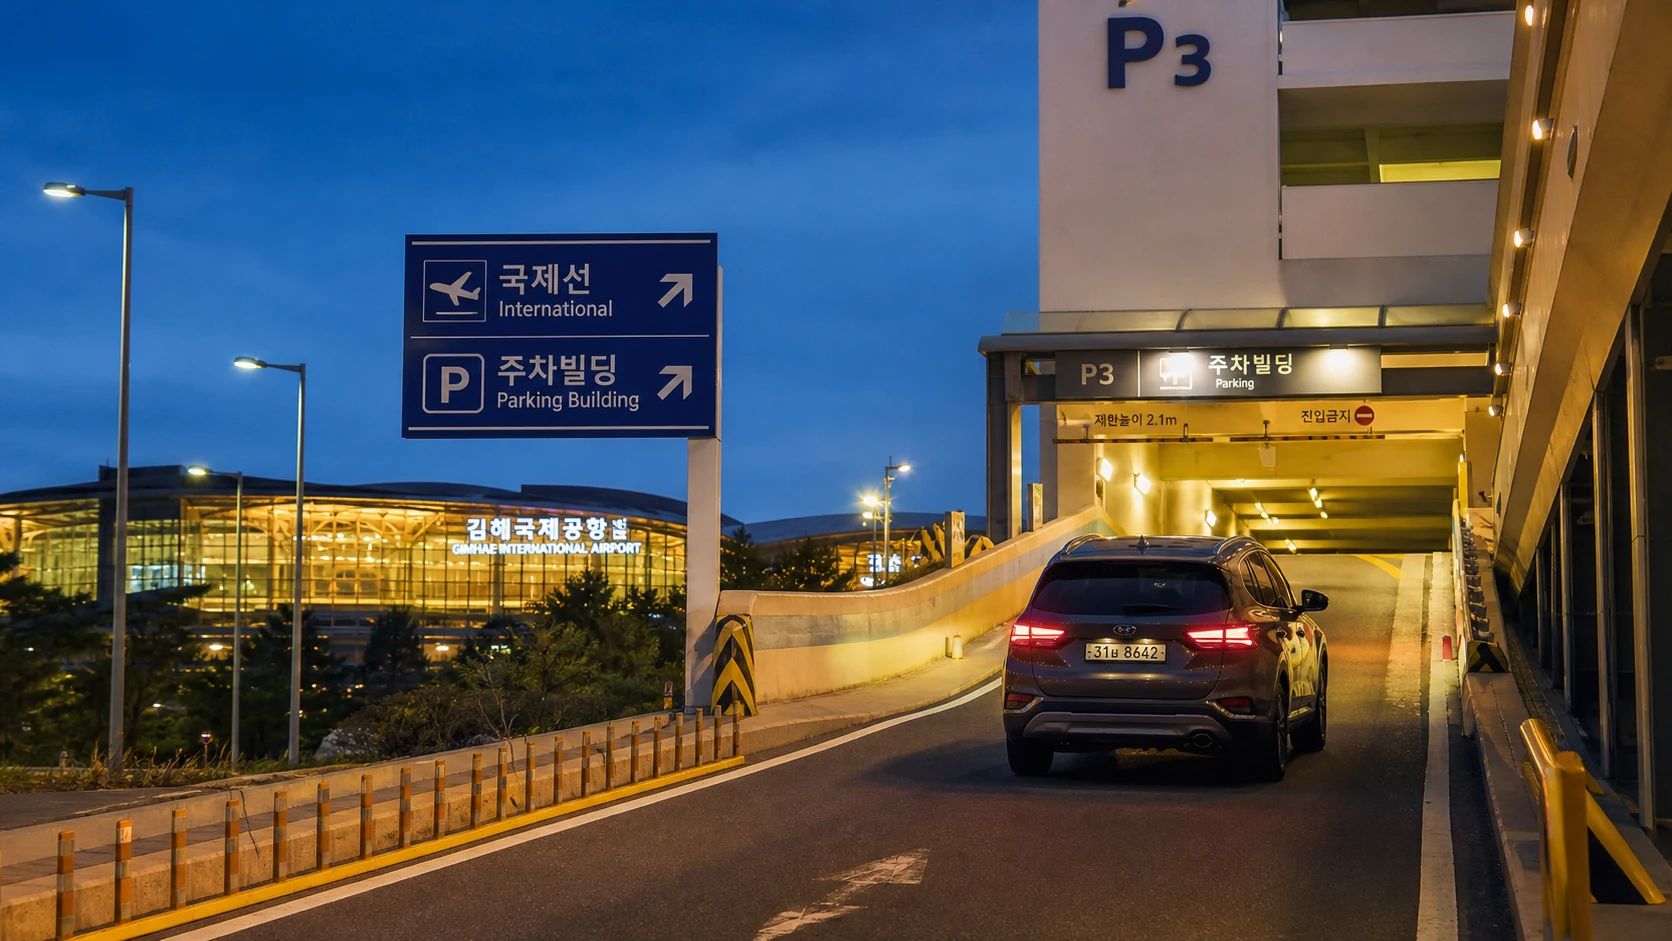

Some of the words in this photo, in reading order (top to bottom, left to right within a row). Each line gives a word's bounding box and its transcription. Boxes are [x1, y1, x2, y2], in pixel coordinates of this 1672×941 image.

[1107, 16, 1212, 89] P3
[499, 263, 590, 295] 국제선
[499, 300, 613, 317] International
[497, 354, 616, 386] 주차빌딩
[1081, 363, 1114, 385] P3
[1208, 353, 1292, 375] 주차빌딩
[440, 366, 470, 403] P
[1215, 377, 1255, 390] Parking
[497, 392, 563, 411] Parking
[568, 391, 640, 411] Building
[1146, 413, 1177, 426] 2.1m
[1301, 409, 1351, 423] 진입금지
[451, 543, 498, 555] GIMHAE
[499, 543, 589, 555] INTERNATIONAL
[590, 541, 642, 554] AIRPORT
[1124, 645, 1158, 659] 8642
